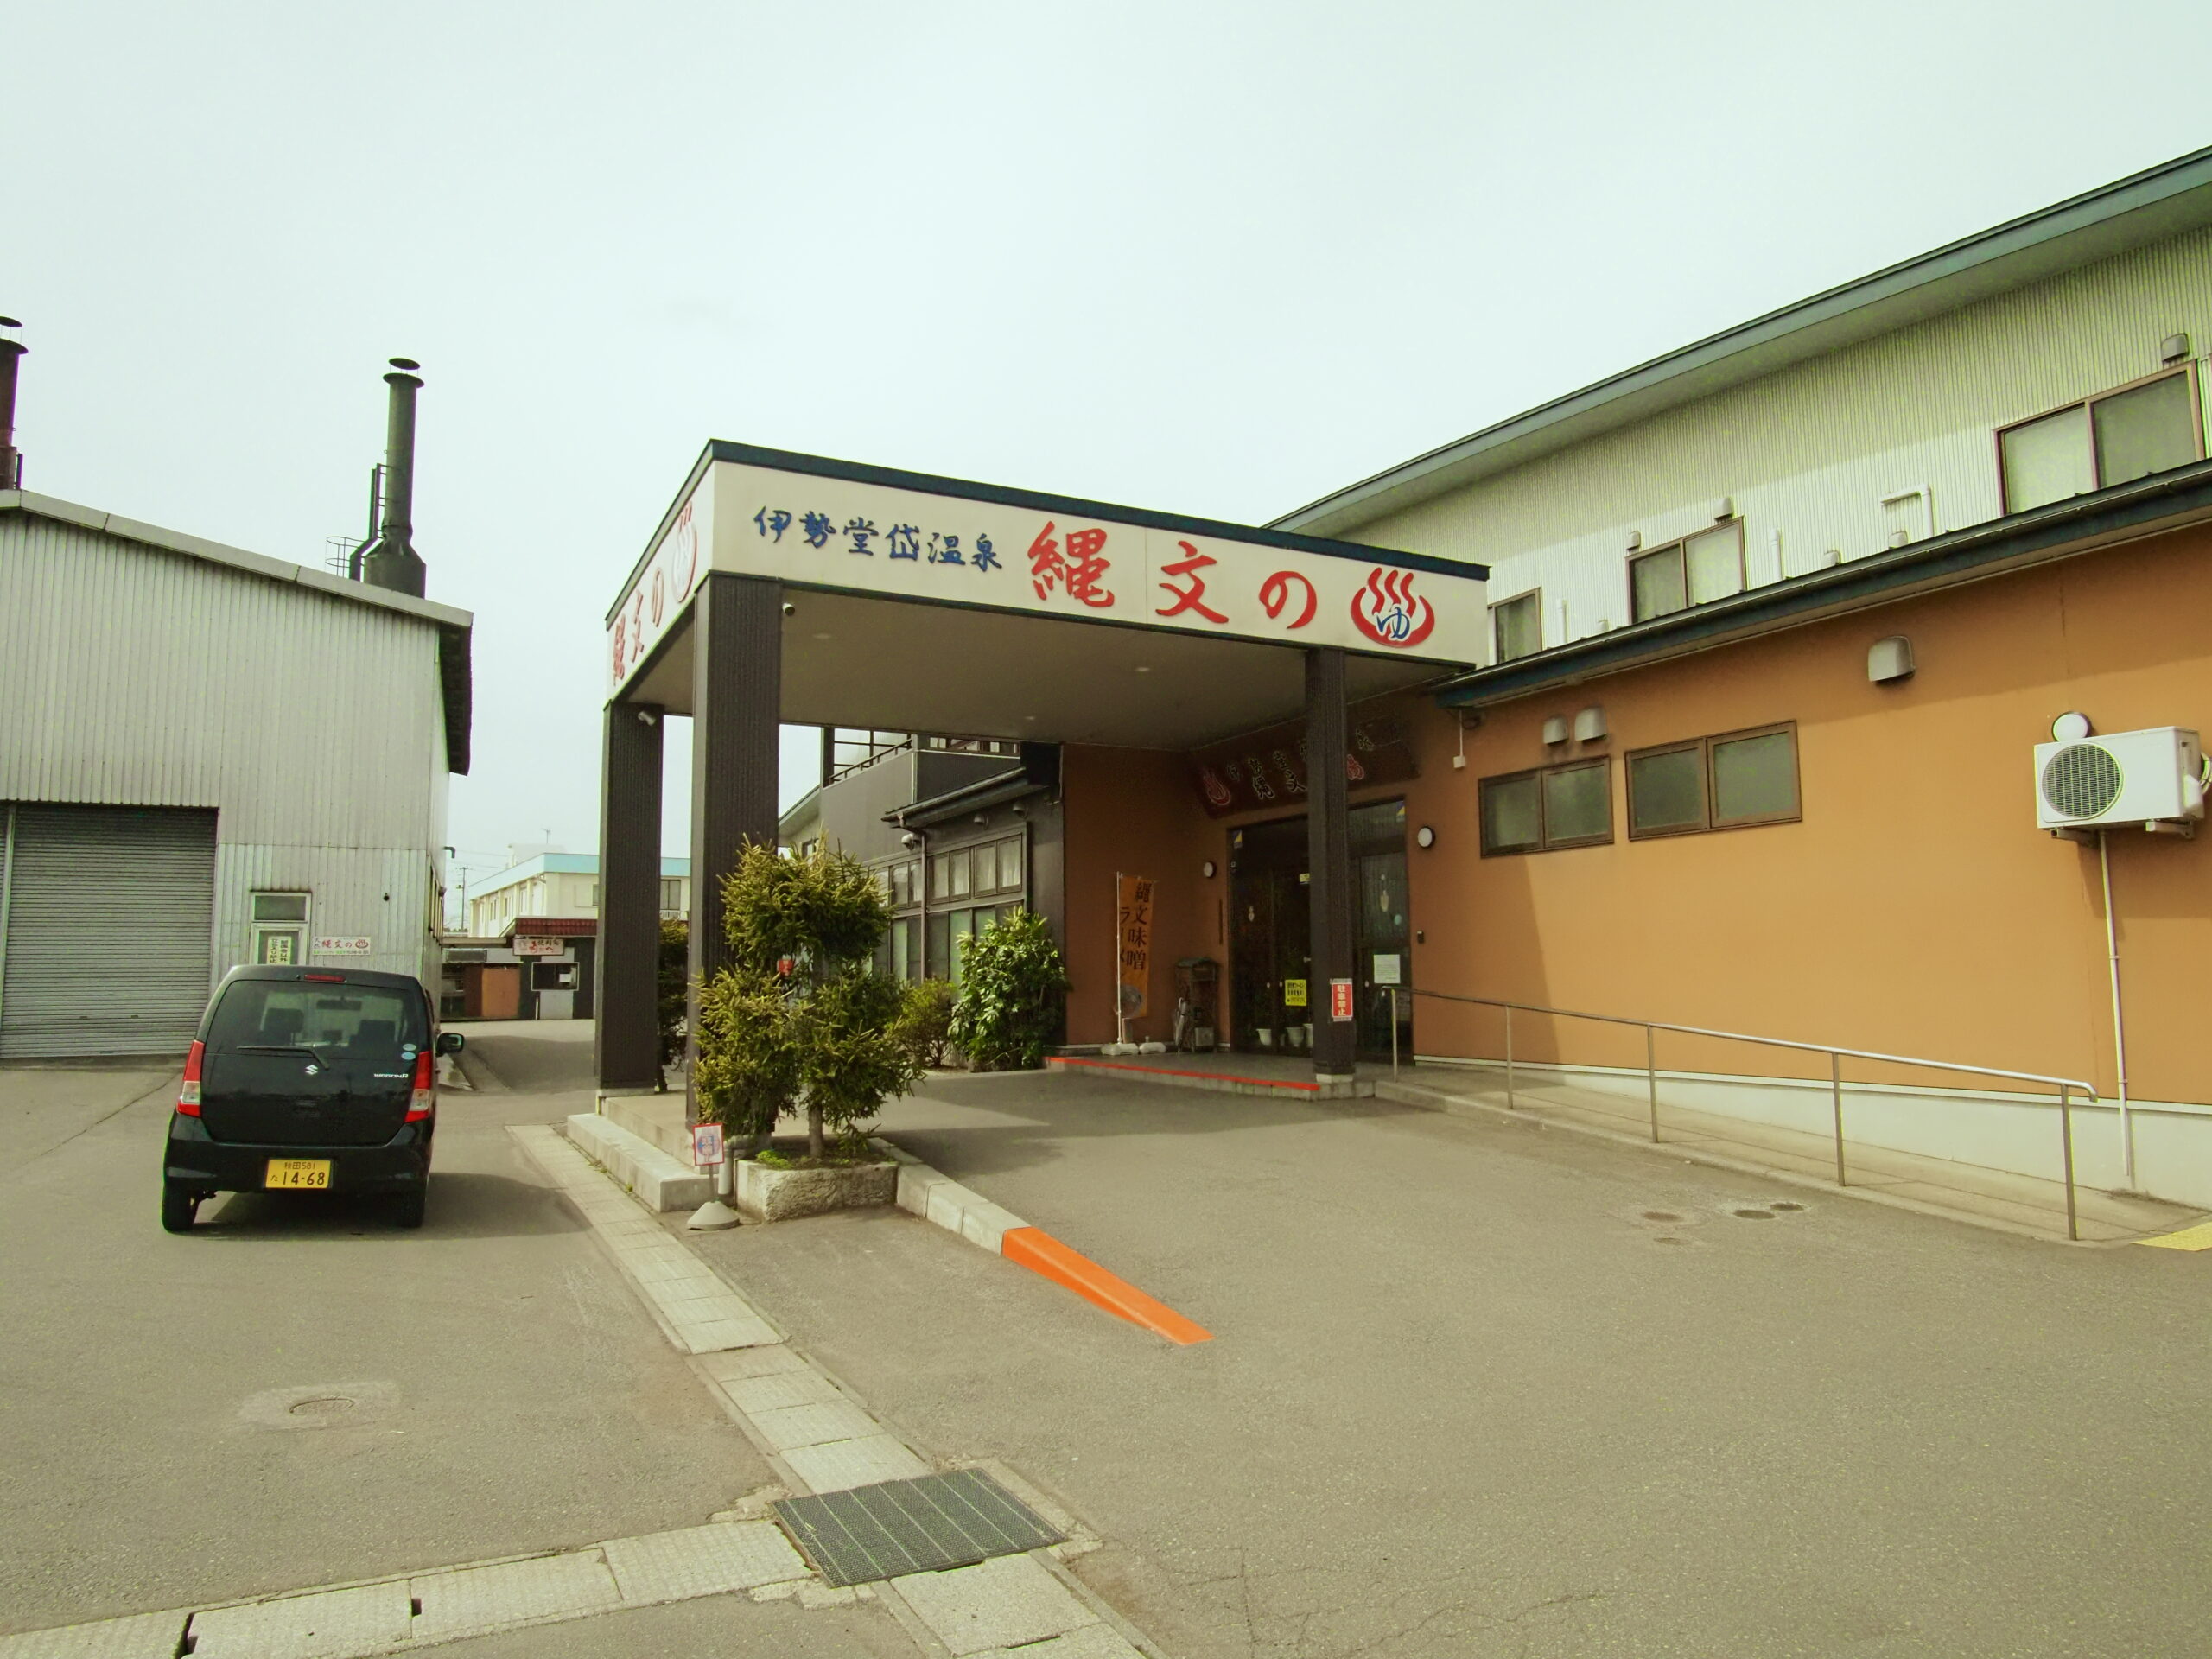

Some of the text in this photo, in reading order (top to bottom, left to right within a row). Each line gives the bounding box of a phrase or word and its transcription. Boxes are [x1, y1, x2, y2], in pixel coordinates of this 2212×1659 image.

[753, 505, 1002, 572] 伊勢堂岱温泉
[1127, 882, 1153, 971] 縄文味噌
[283, 1171, 325, 1185] 14-68
